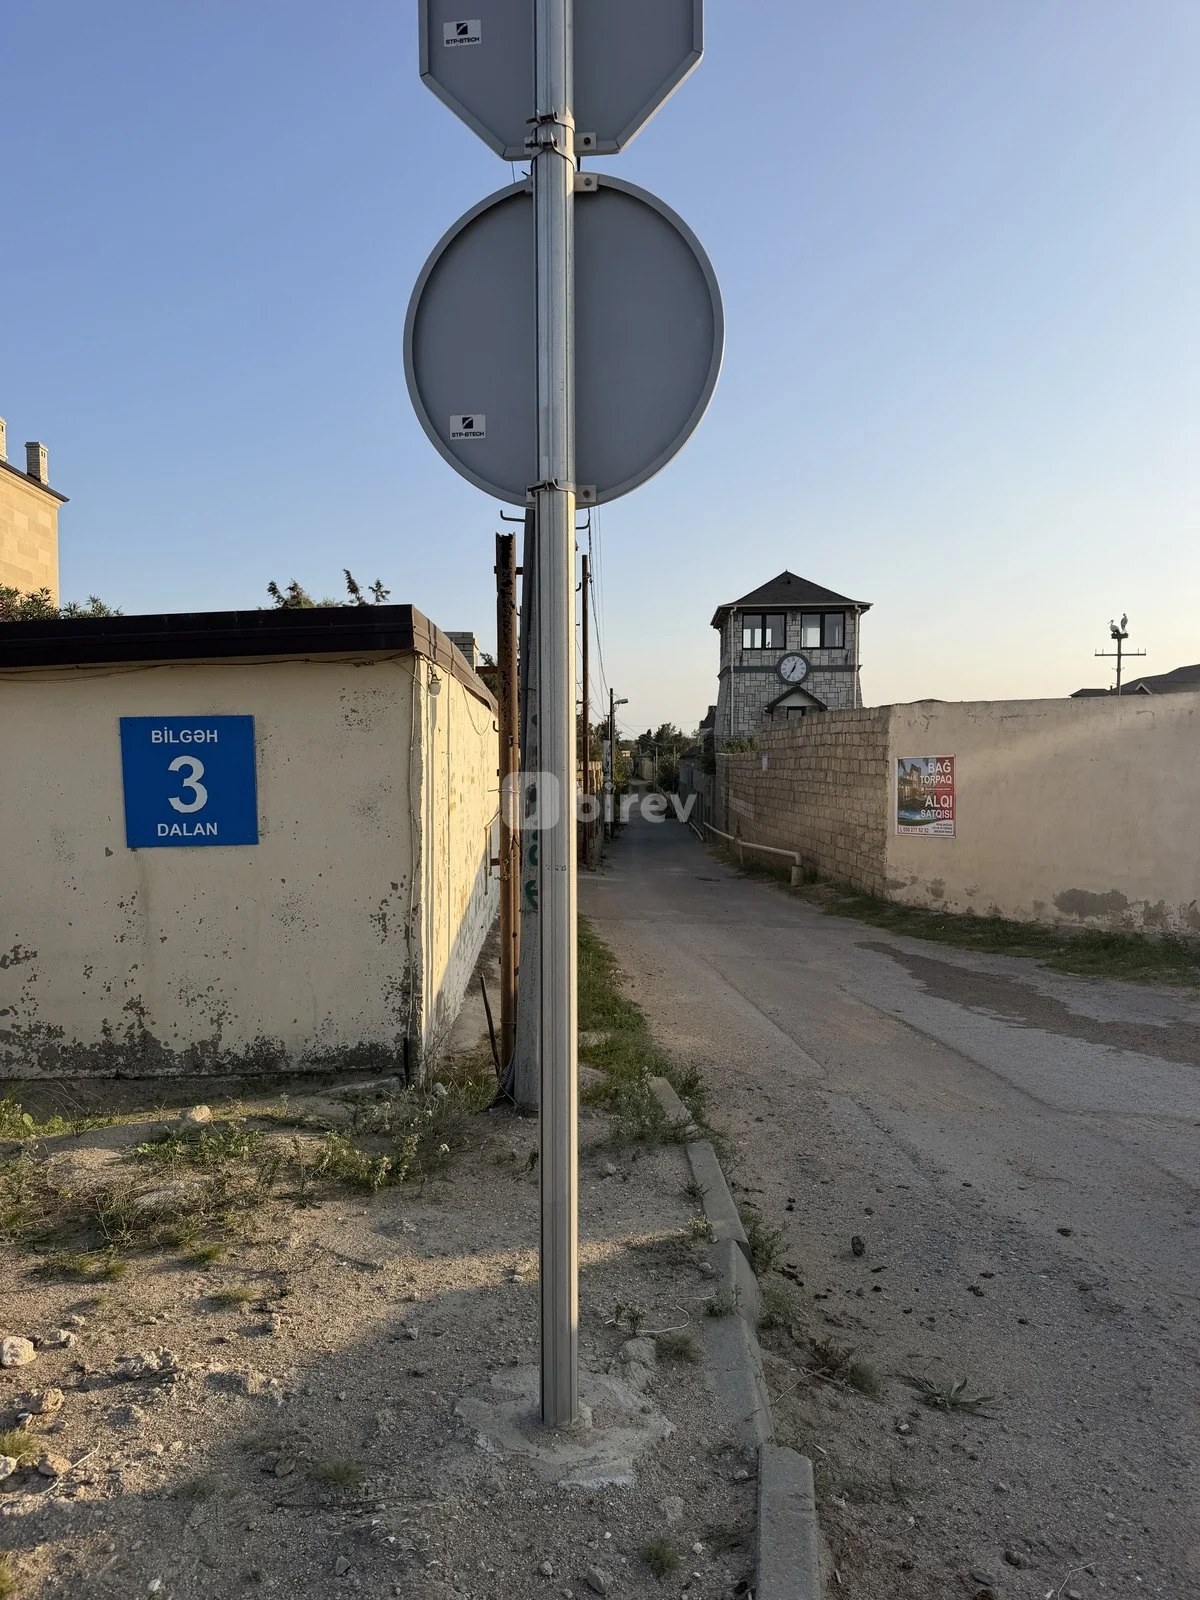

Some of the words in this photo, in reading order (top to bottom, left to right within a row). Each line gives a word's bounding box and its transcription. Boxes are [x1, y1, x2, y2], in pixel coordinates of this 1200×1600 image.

[151, 727, 218, 744] BİLGƏH
[928, 759, 951, 773] BAĞ
[168, 755, 208, 813] 3
[920, 775, 952, 784] TORPAQ
[925, 795, 952, 808] ALQI
[920, 809, 952, 819] SATQISI
[157, 822, 218, 837] DALAN
